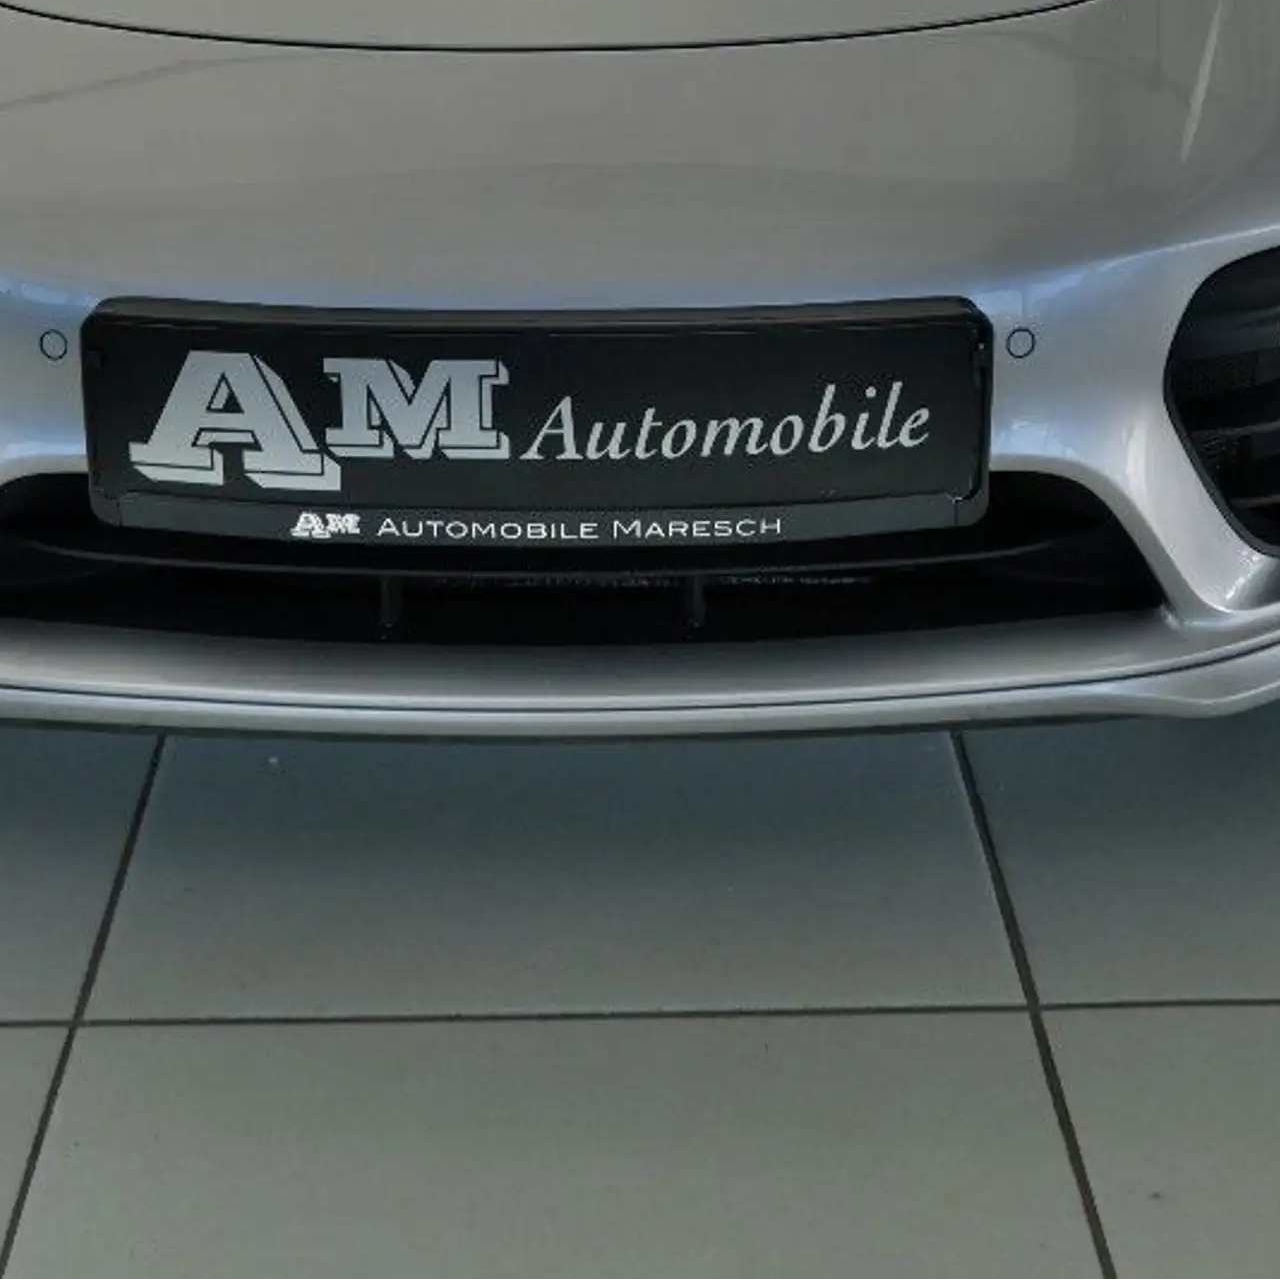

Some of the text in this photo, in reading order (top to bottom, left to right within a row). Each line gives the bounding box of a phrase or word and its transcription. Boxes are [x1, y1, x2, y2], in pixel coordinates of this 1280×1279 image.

[129, 350, 929, 490] AM Automobile
[291, 511, 361, 538] AM
